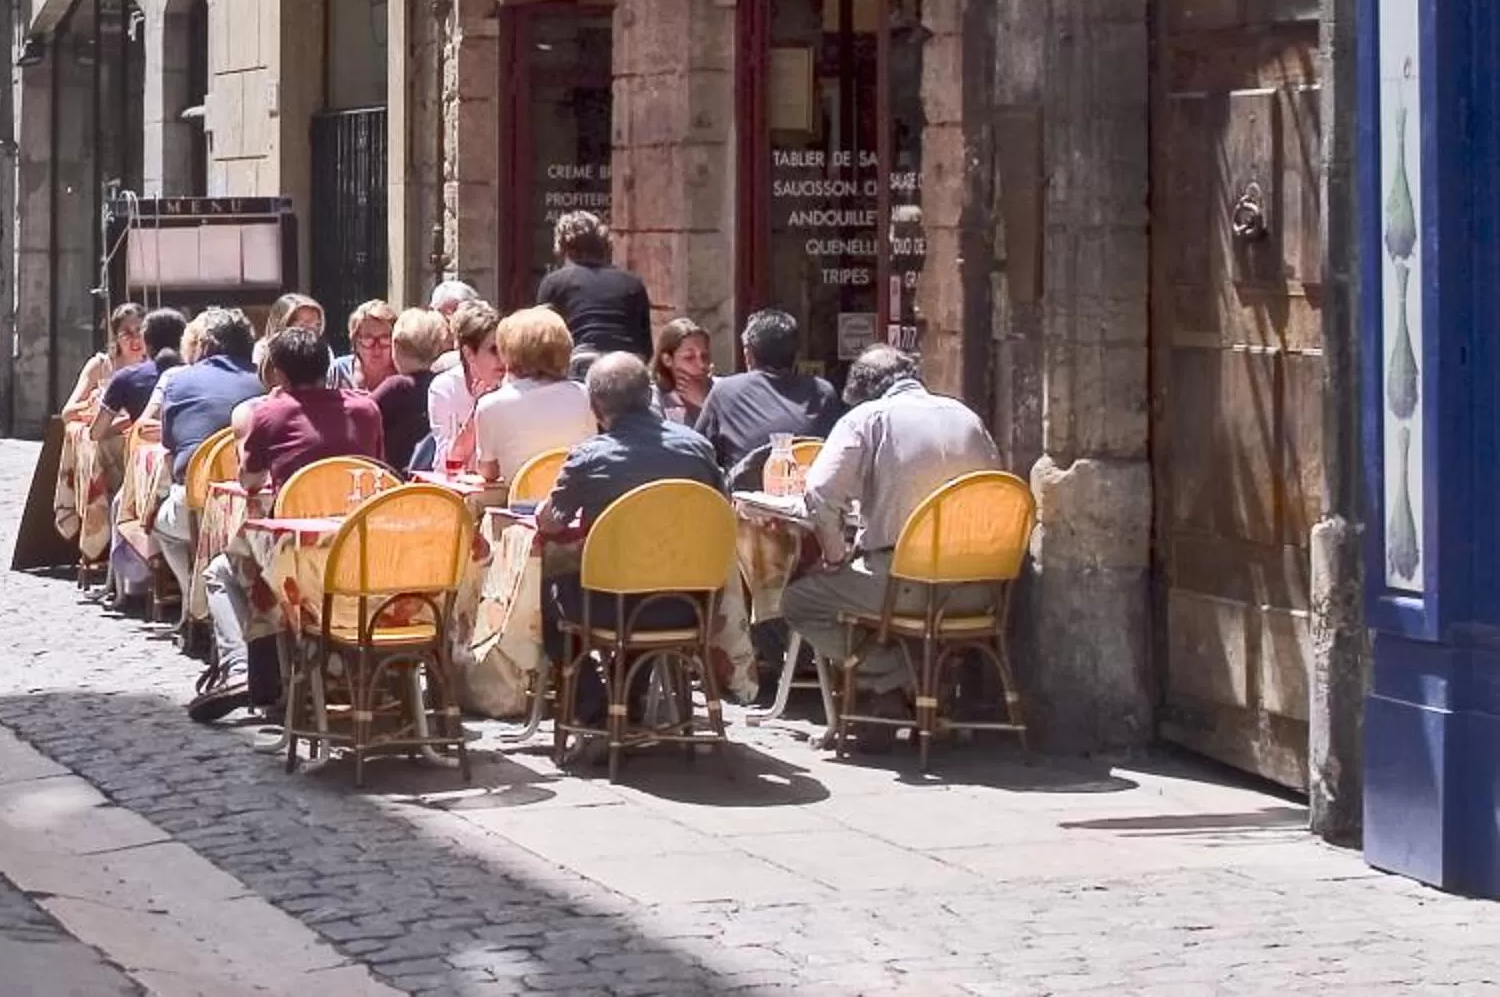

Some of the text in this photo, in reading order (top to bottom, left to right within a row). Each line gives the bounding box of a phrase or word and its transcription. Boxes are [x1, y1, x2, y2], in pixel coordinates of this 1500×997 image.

[773, 151, 825, 167] TABLIER
[833, 151, 851, 167] DE
[773, 180, 857, 196] SAUCISSON
[167, 199, 242, 213] MENU
[822, 268, 869, 285] TRIPES
